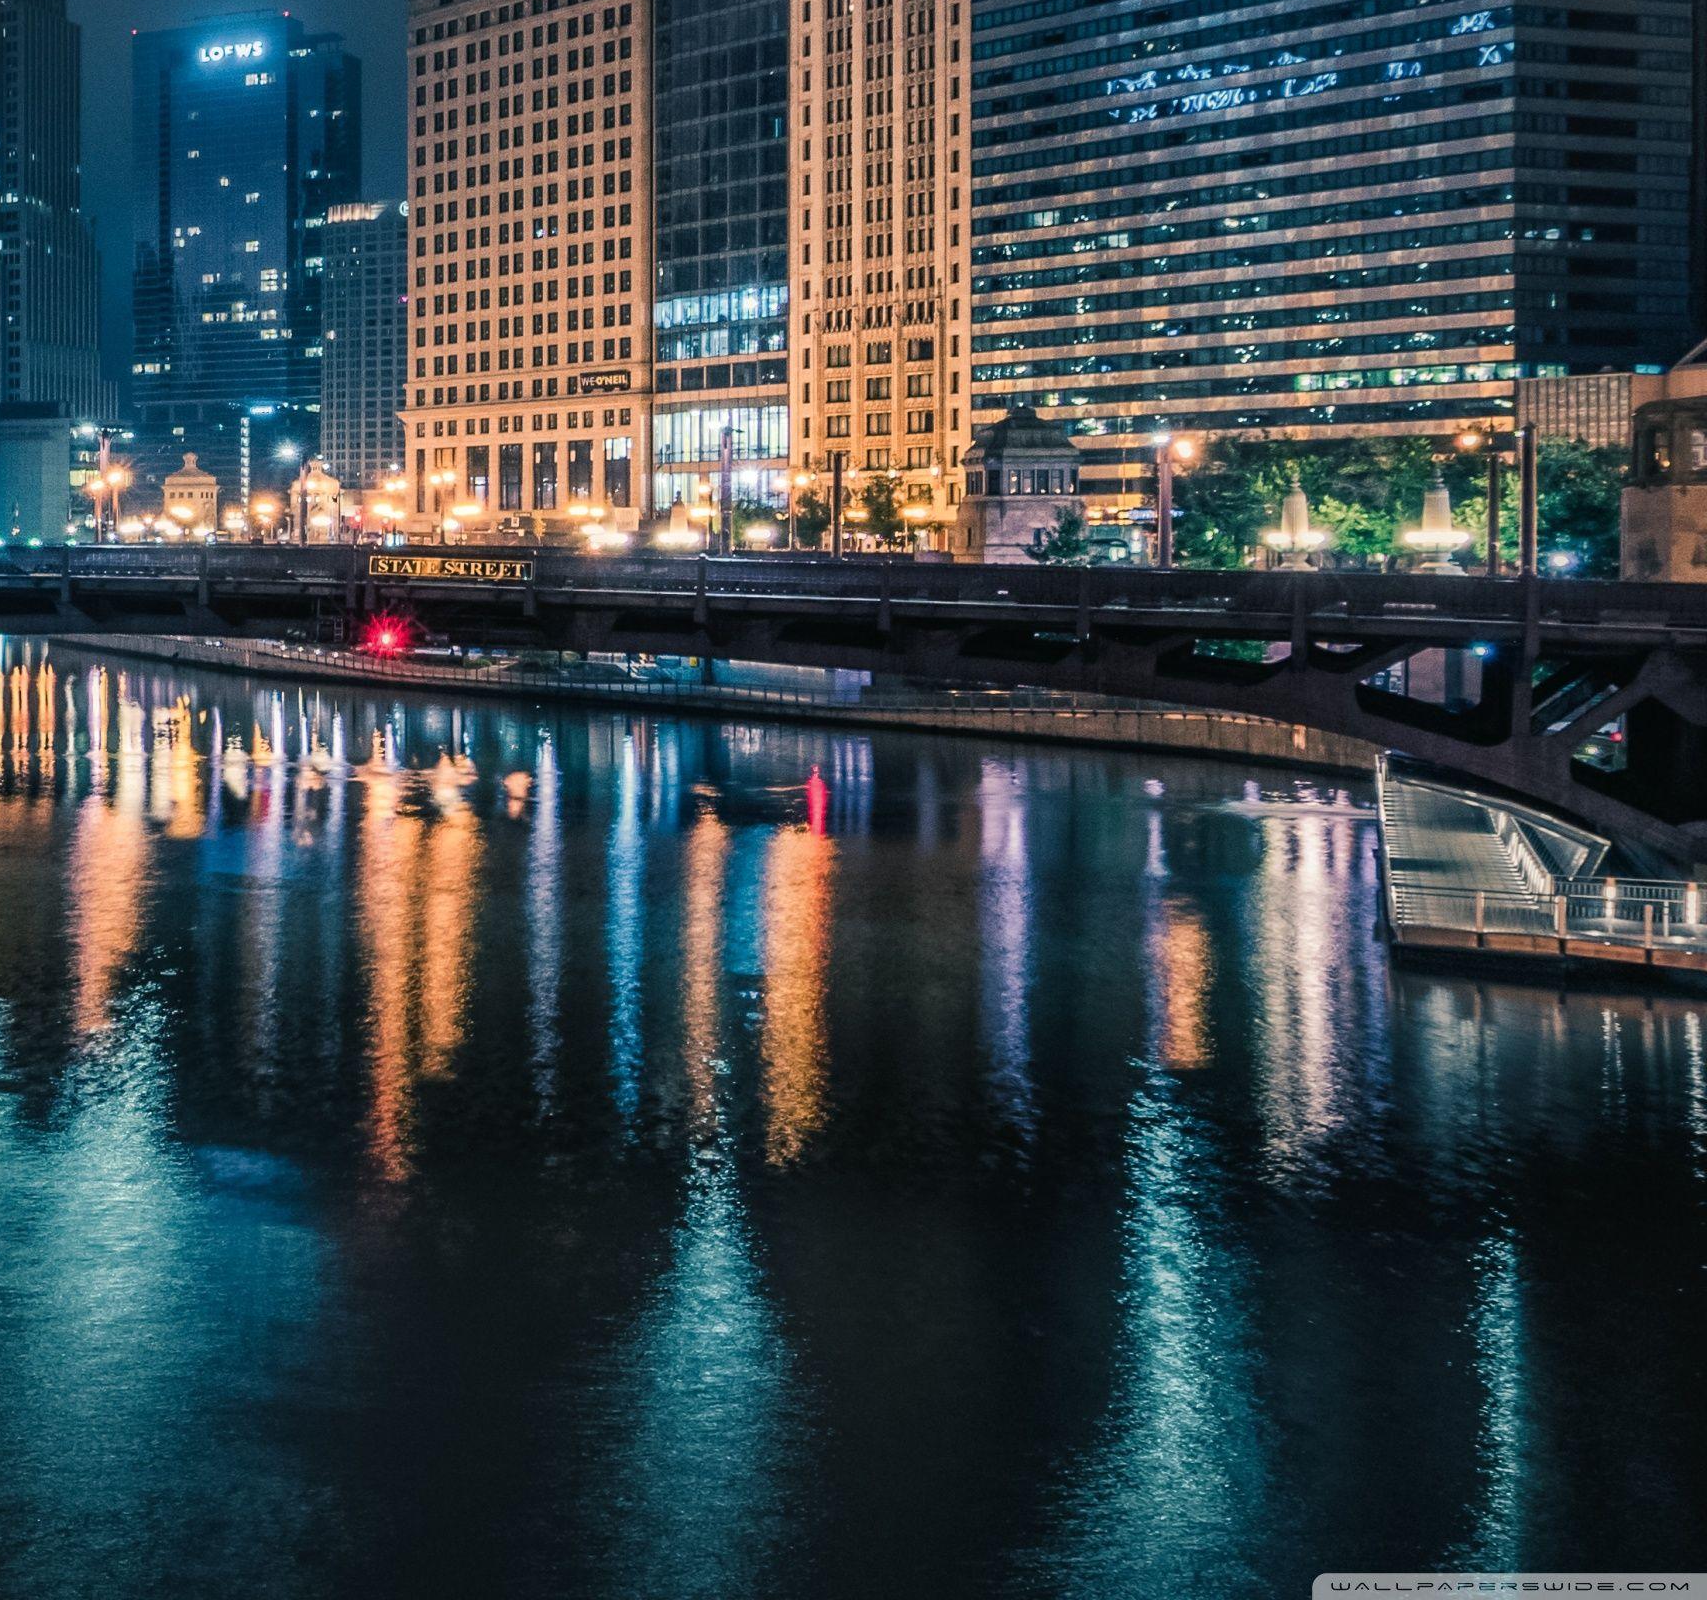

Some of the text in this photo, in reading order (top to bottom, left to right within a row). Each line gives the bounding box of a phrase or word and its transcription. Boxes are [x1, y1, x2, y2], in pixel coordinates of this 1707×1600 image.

[595, 374, 627, 386] O'NEIL
[377, 558, 525, 578] STATE STREET
